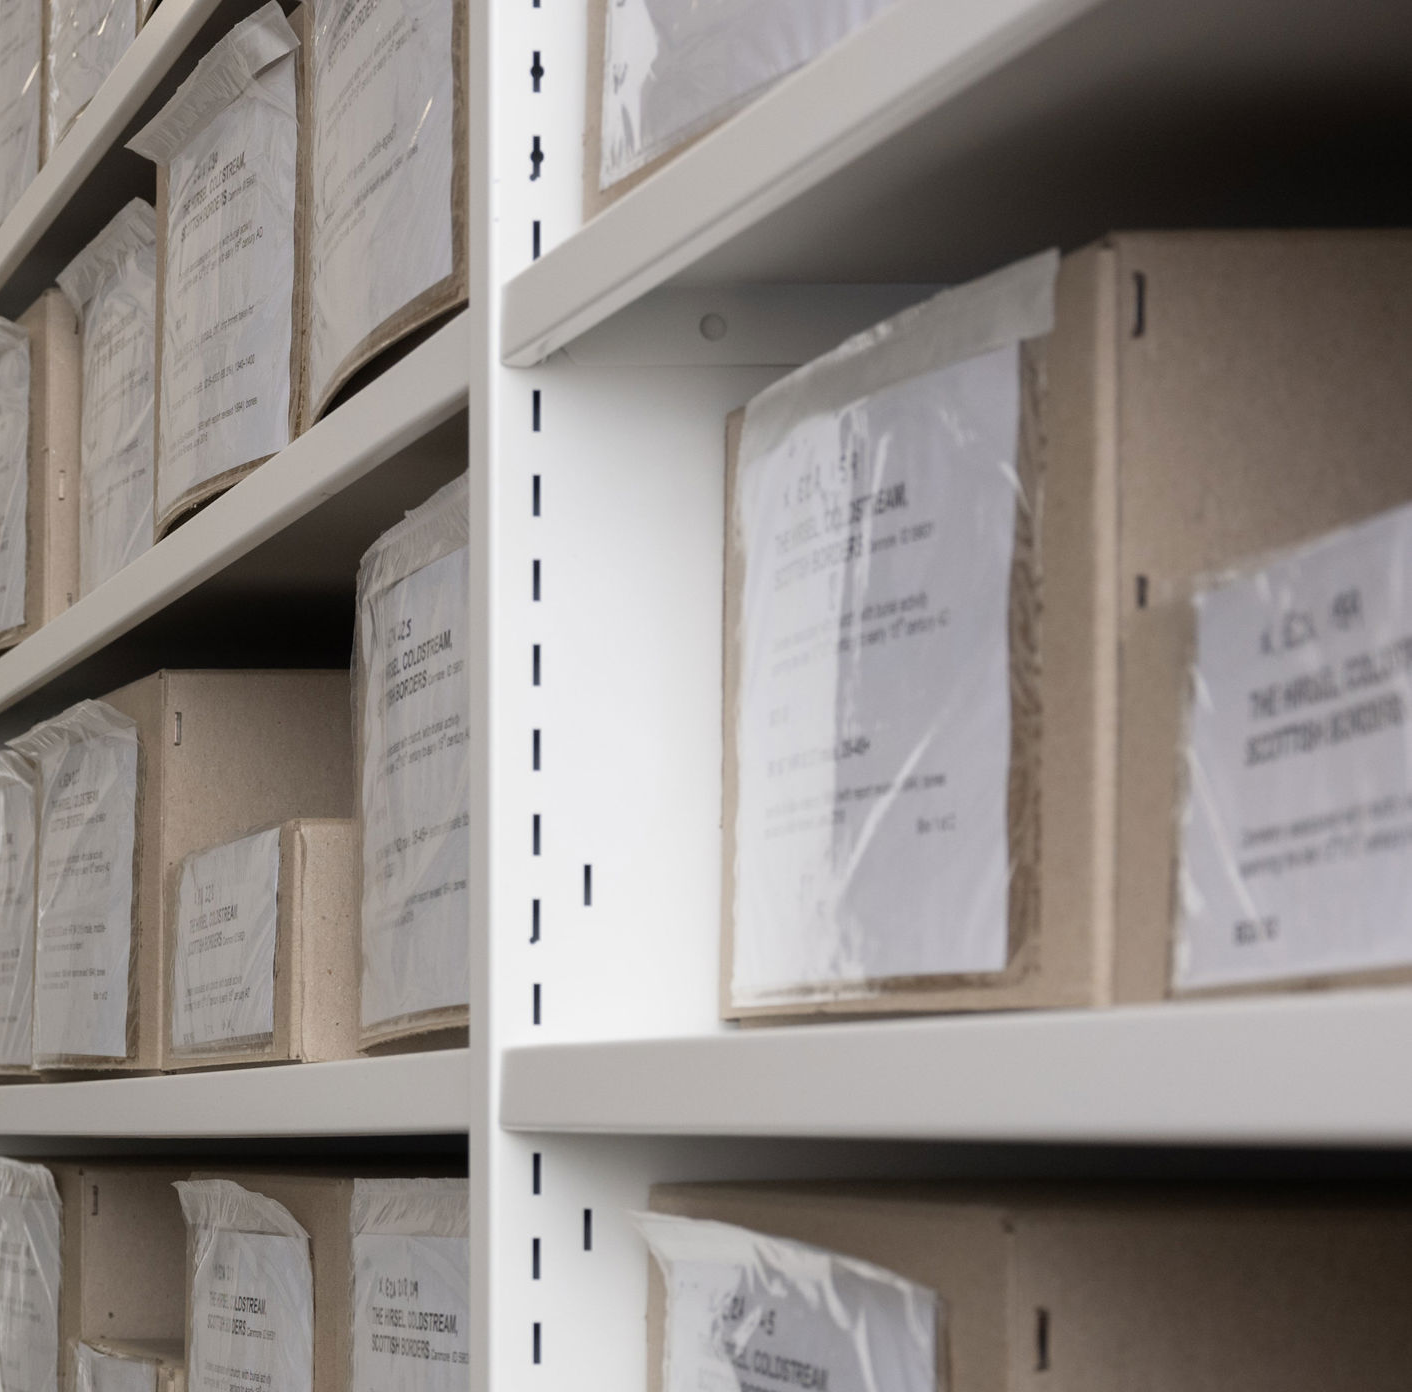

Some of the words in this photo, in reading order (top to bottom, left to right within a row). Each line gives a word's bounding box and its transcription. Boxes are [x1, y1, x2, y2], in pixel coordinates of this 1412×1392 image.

[402, 628, 454, 671] COLDSTREAM,
[395, 669, 428, 703] BORDERS
[372, 1306, 384, 1326] THE
[407, 1310, 459, 1337] COLDSTREAM,
[371, 1333, 400, 1355] SCOTTISH
[401, 1337, 431, 1360] BORDERS
